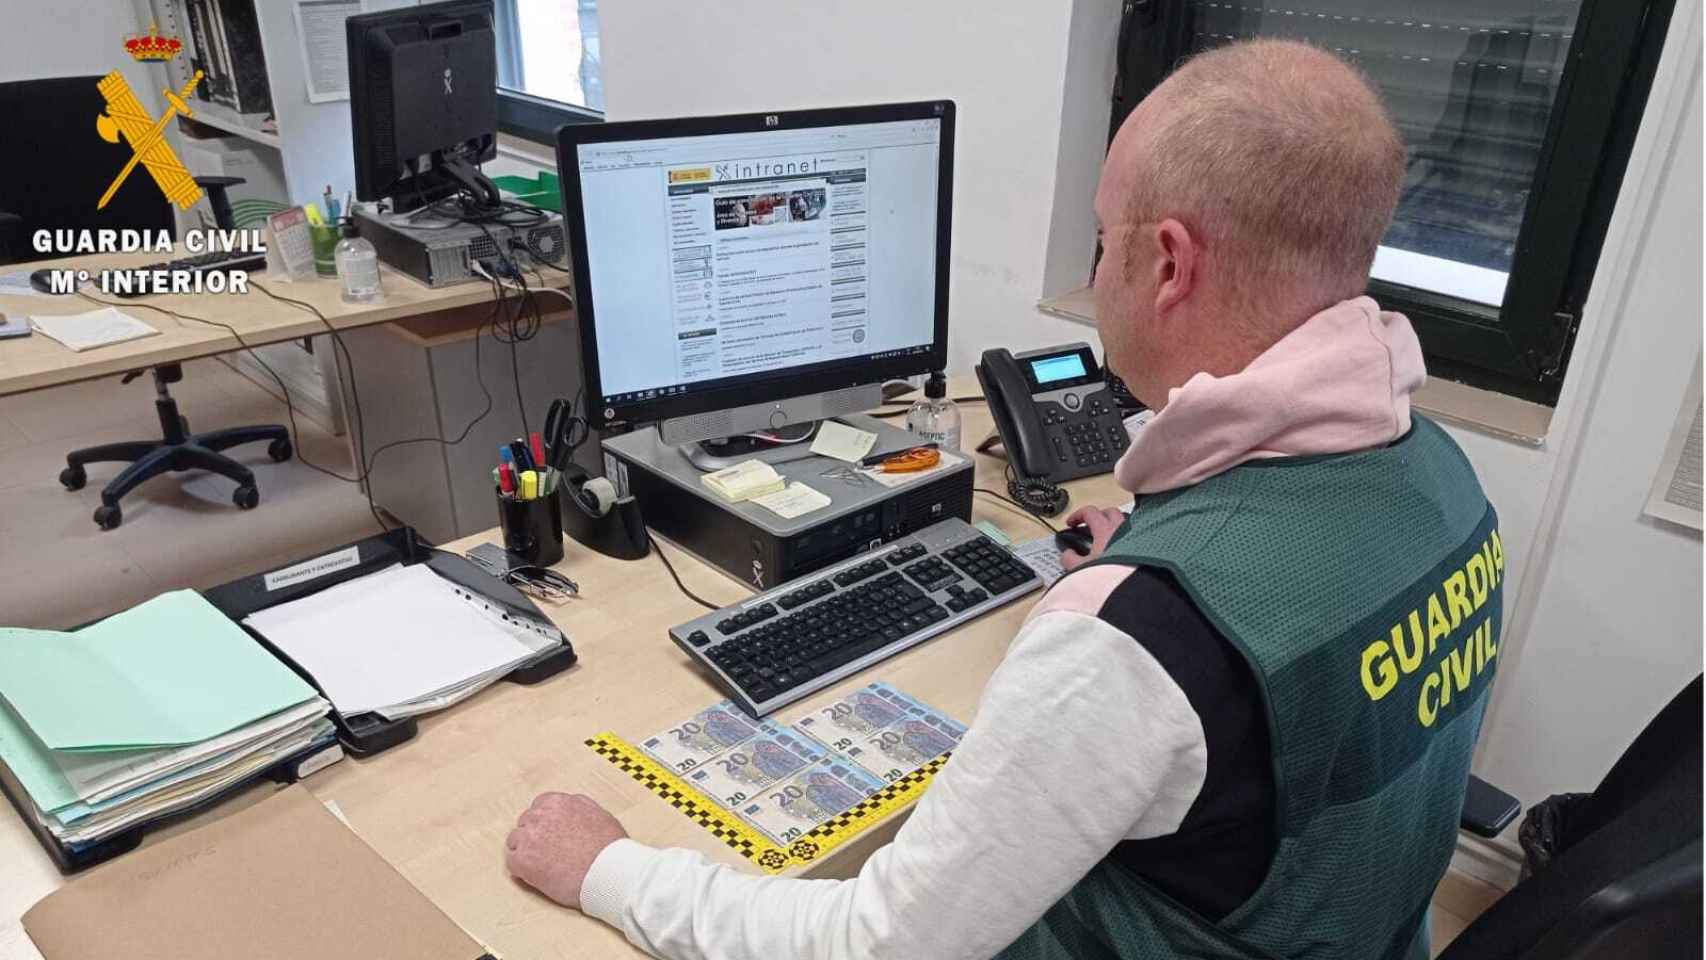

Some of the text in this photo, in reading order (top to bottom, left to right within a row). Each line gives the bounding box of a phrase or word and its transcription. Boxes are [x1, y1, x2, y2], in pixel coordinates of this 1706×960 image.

[735, 157, 818, 179] intranet
[1360, 528, 1504, 701] GUARDIA
[1418, 616, 1497, 728] CIVIL
[822, 702, 853, 720] 20
[668, 722, 701, 740] 20
[833, 737, 853, 751] 20
[869, 731, 901, 751] 20
[676, 758, 697, 771] 20
[716, 753, 749, 772] 20
[883, 768, 903, 782] 20
[726, 791, 746, 806] 20
[769, 785, 804, 808] 20
[780, 827, 802, 842] 20
